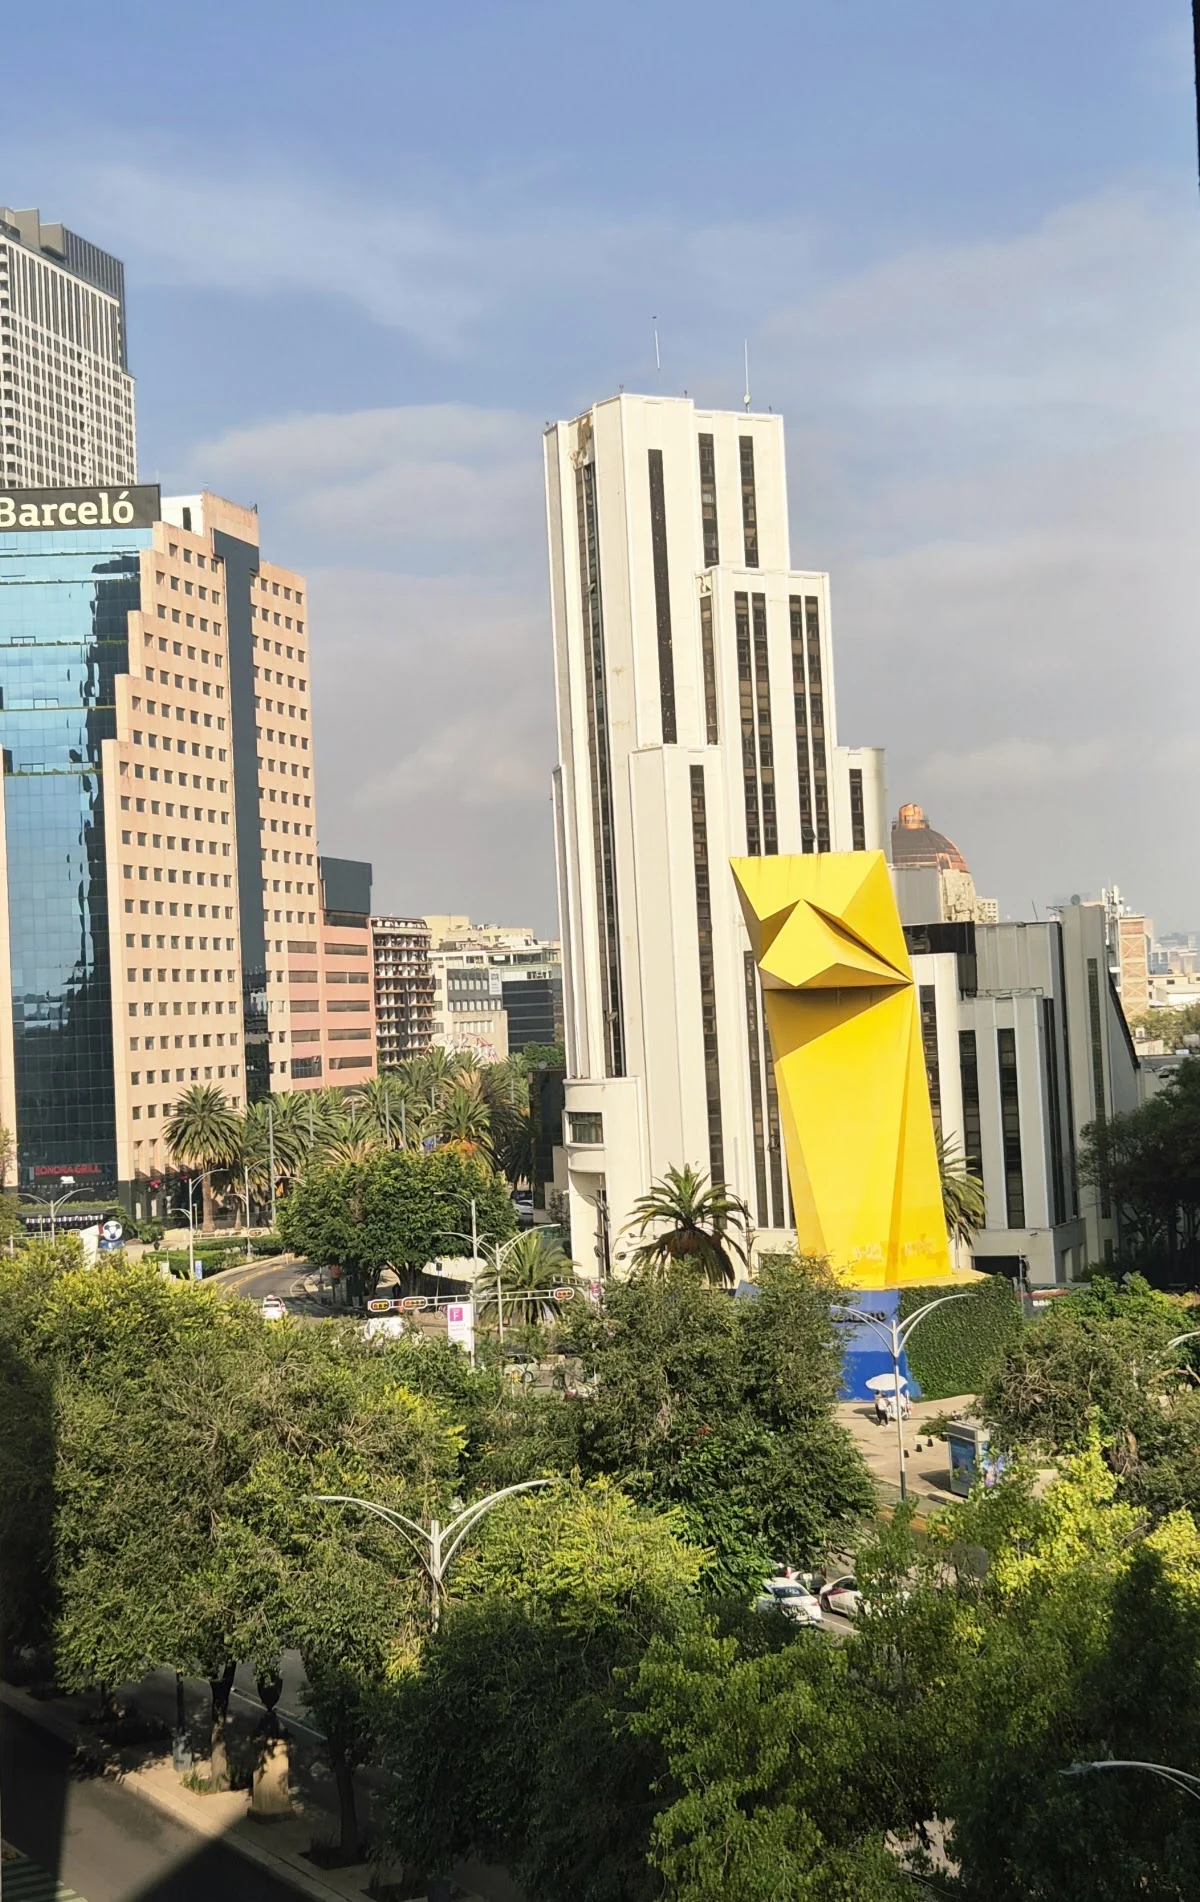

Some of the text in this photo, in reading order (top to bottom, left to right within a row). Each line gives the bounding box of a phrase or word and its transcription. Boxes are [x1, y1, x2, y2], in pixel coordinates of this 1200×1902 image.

[0, 491, 134, 527] Barceló
[35, 1163, 102, 1176] SONORA GRILL
